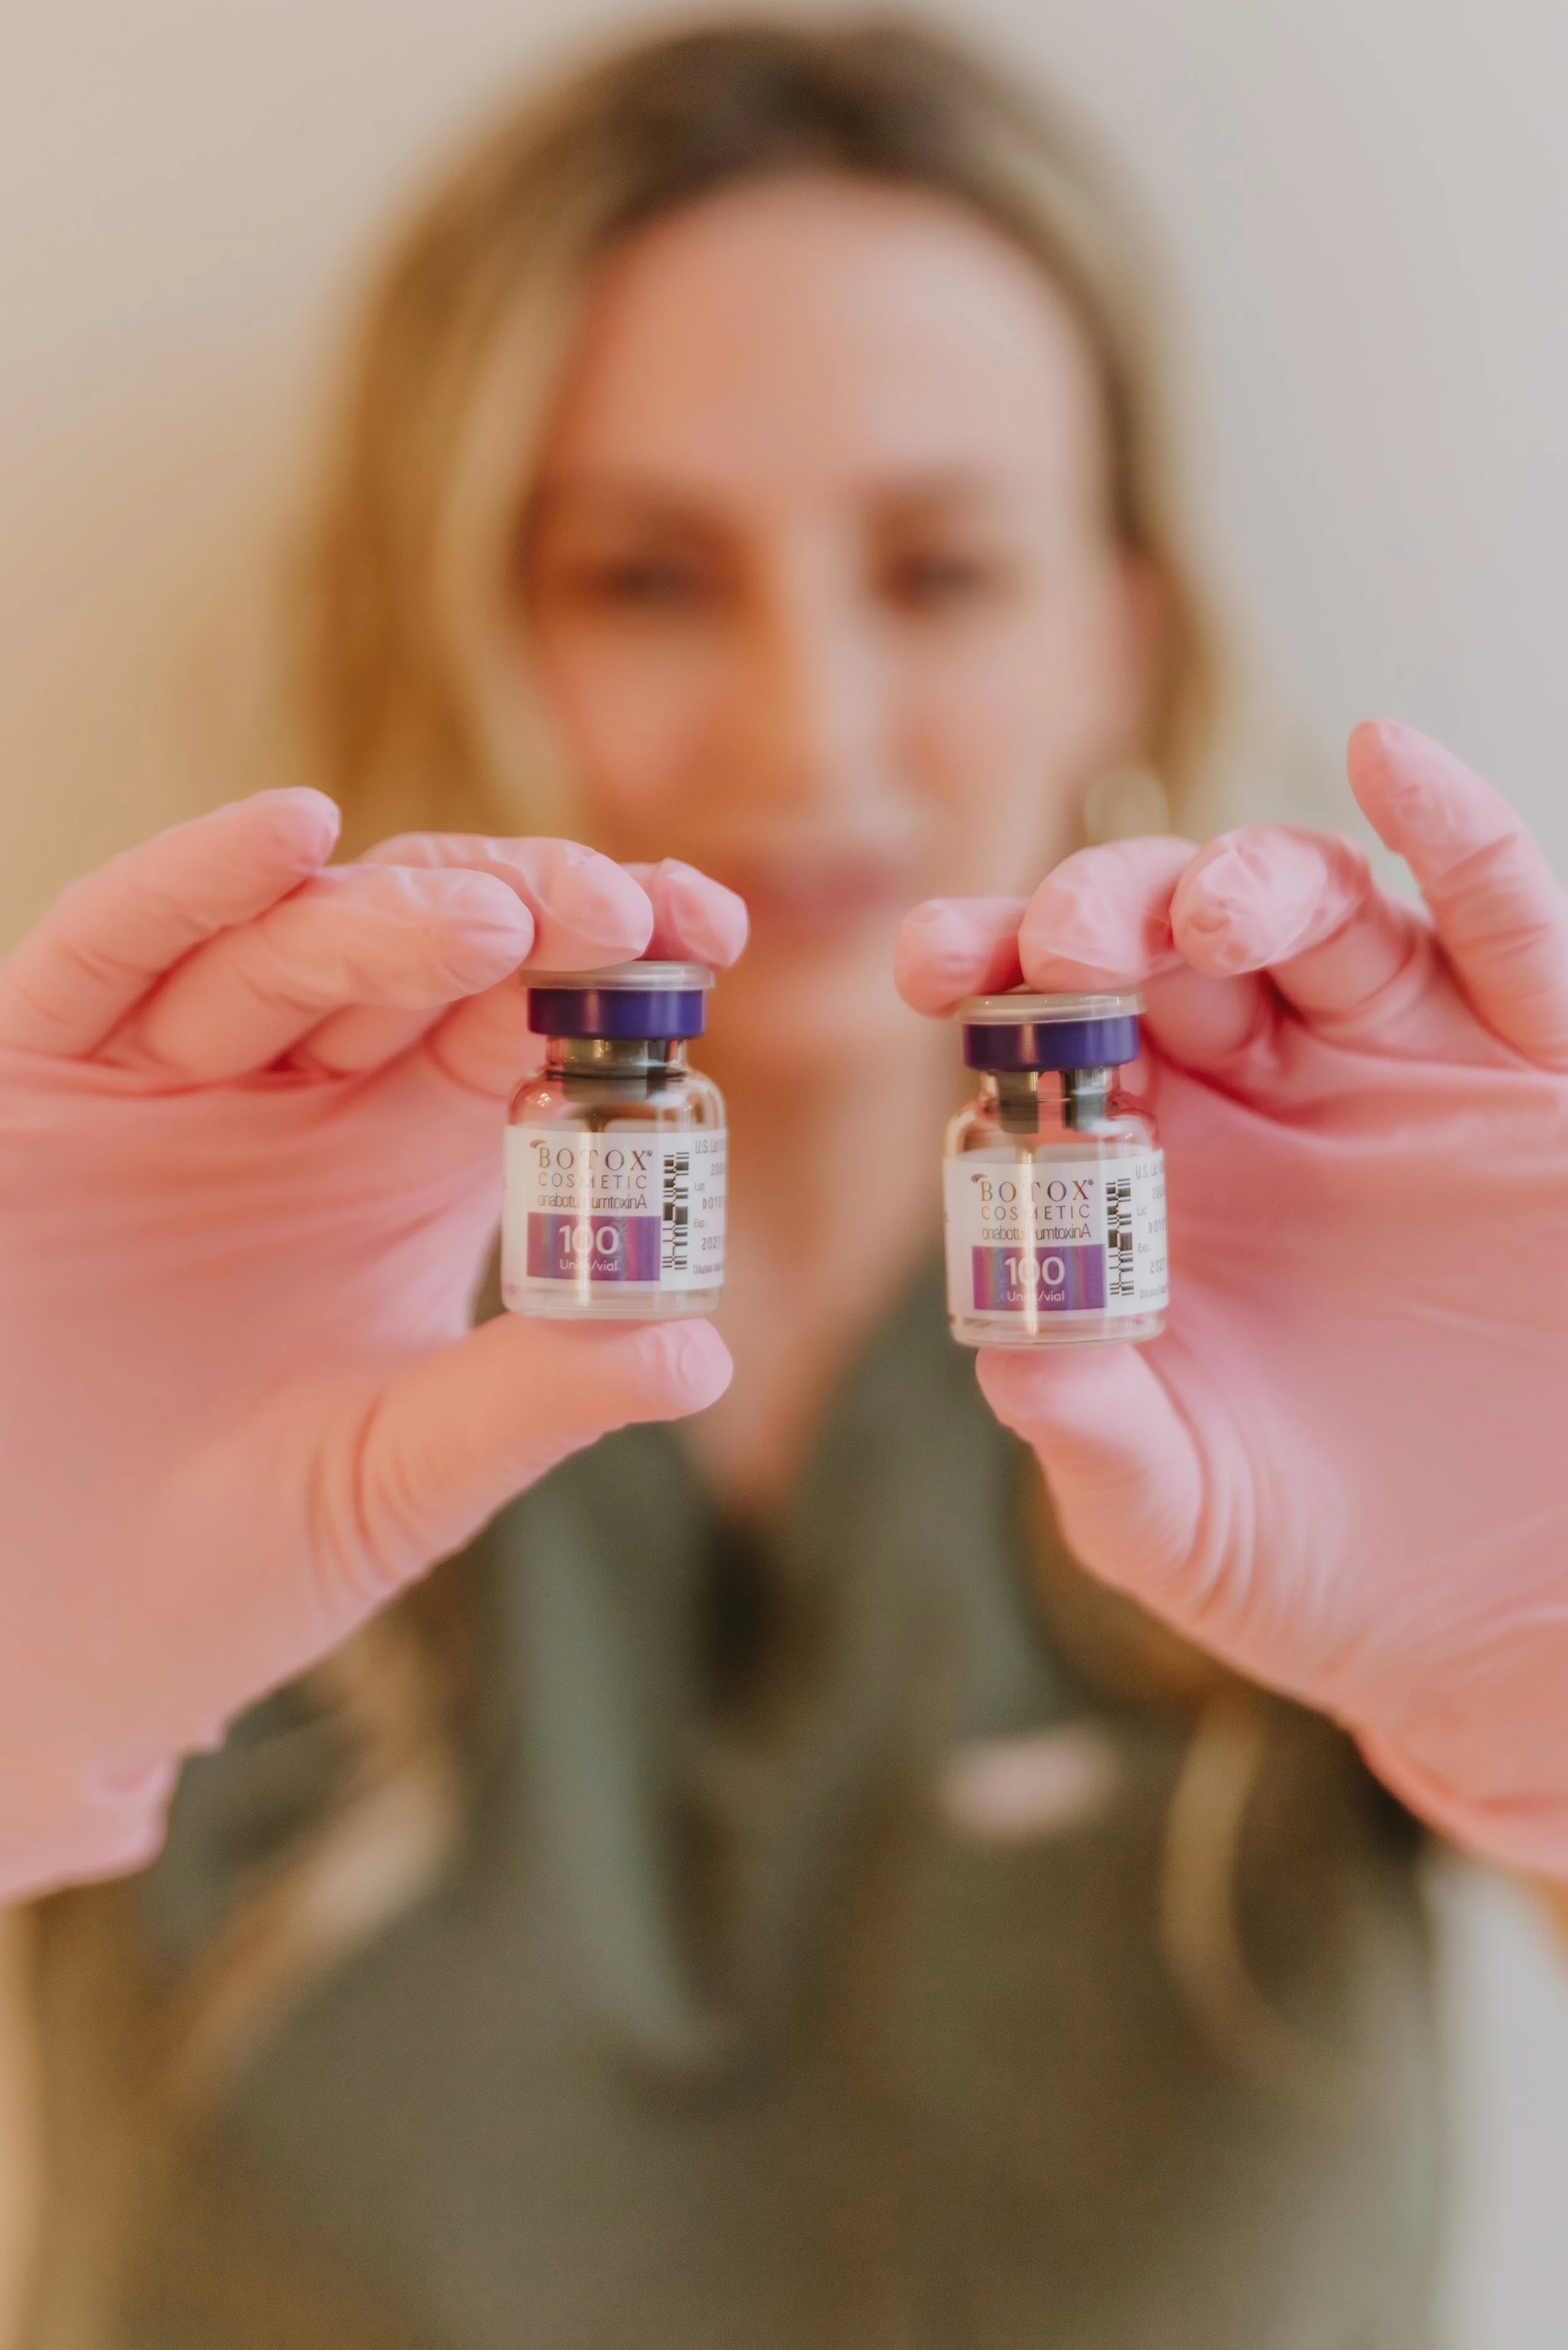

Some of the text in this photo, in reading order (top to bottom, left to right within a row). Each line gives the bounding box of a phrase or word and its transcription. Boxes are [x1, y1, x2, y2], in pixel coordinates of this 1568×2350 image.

[538, 1192, 647, 1210] onabotuumtoxinA
[559, 1225, 620, 1255] 100
[982, 1223, 1092, 1240] onabotulumtoxinA
[559, 1258, 619, 1272] Un/vial
[1004, 1256, 1066, 1286] 100
